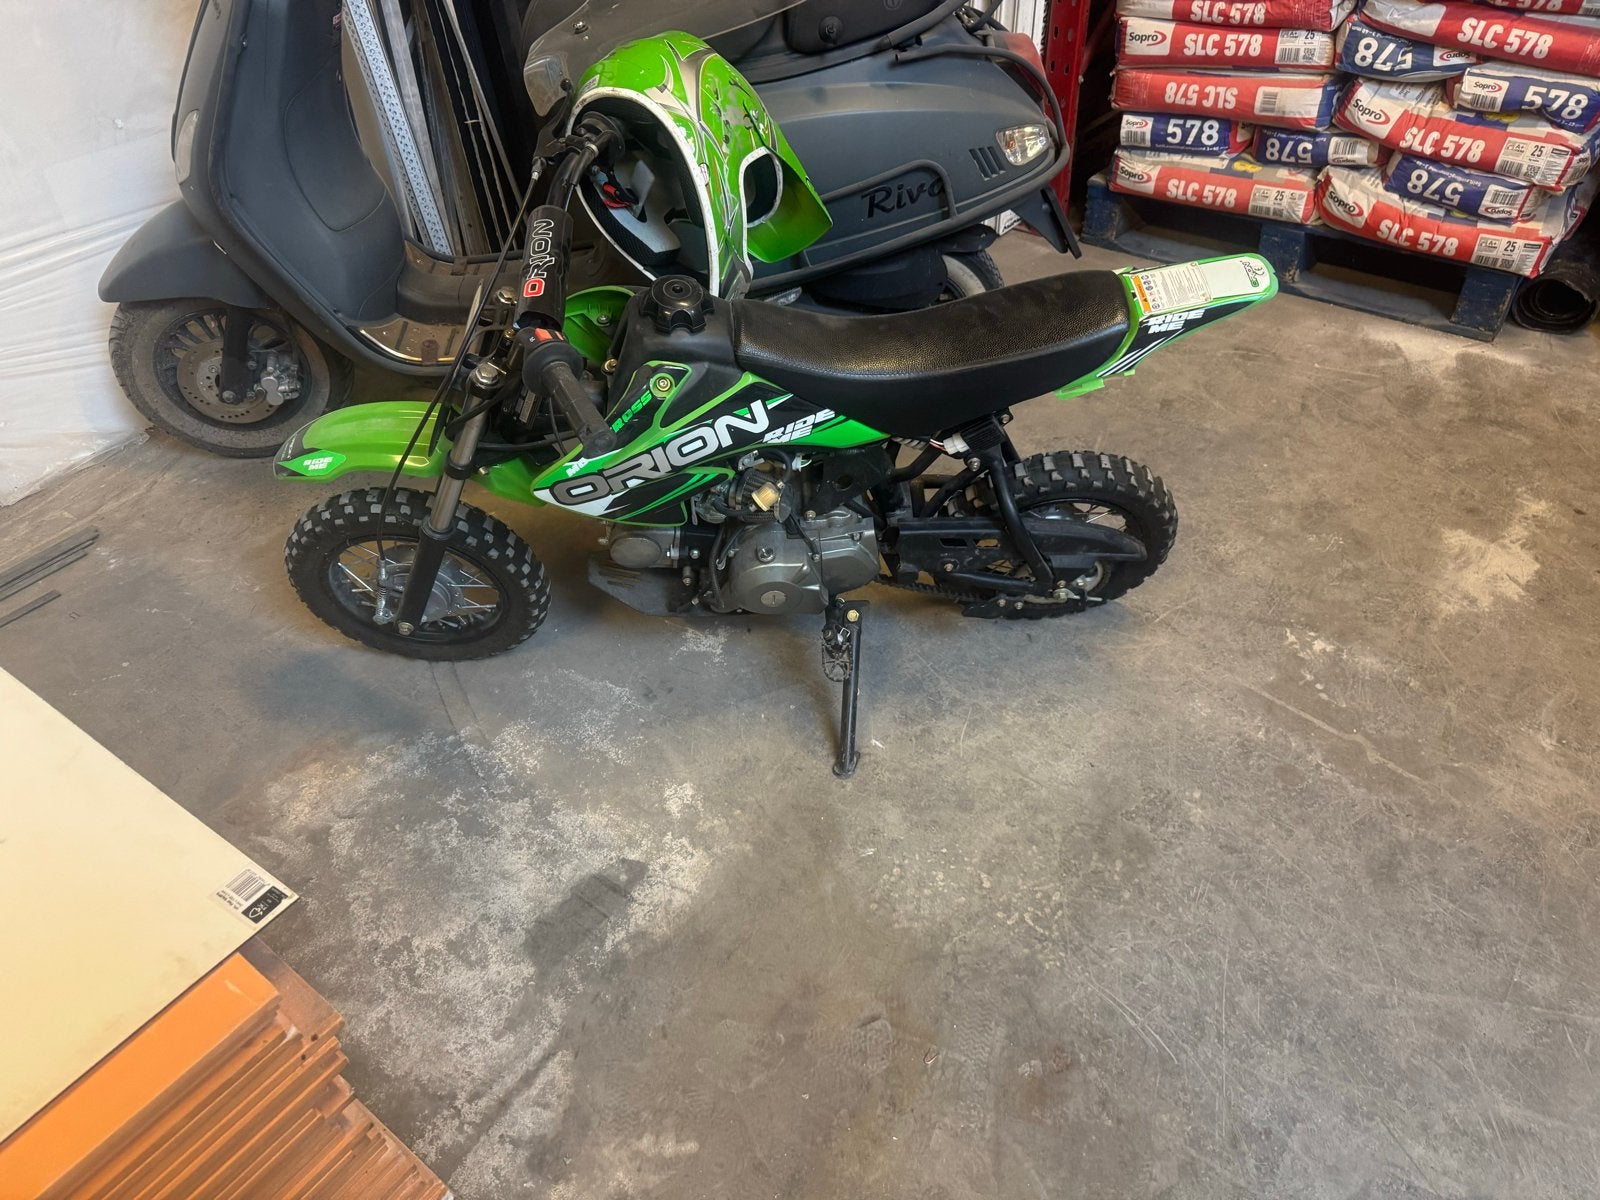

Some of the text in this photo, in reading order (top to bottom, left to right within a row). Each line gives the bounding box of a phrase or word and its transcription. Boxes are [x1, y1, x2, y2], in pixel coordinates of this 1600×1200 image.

[1190, 0, 1266, 25] SLC 578
[1129, 31, 1159, 44] Sopro
[1183, 33, 1263, 57] SLC 578
[1304, 30, 1316, 40] 25
[1457, 17, 1554, 59] SLC 578
[1353, 37, 1413, 72] 578
[1164, 81, 1239, 109] SLC 578
[1473, 81, 1498, 91] Sopro
[1352, 99, 1382, 121] Sopro
[1521, 85, 1589, 120] 578
[1166, 118, 1220, 146] 578
[1265, 138, 1313, 164] 578
[1400, 127, 1486, 164] SLC 578
[1531, 145, 1545, 157] 25
[1119, 166, 1144, 181] Sopro
[1166, 178, 1238, 209] SLC 578
[1274, 190, 1285, 202] 25
[1406, 169, 1465, 206] 578
[1327, 190, 1357, 214] Sopro
[1376, 219, 1459, 256] SLC 578
[1503, 240, 1517, 253] 25
[523, 218, 555, 298] ORION
[1147, 308, 1206, 325] RIDE
[1148, 320, 1185, 334] ME
[610, 389, 652, 433] ROSS
[762, 408, 836, 439] RIDE
[766, 427, 814, 444] ME
[551, 399, 770, 505] ORION
